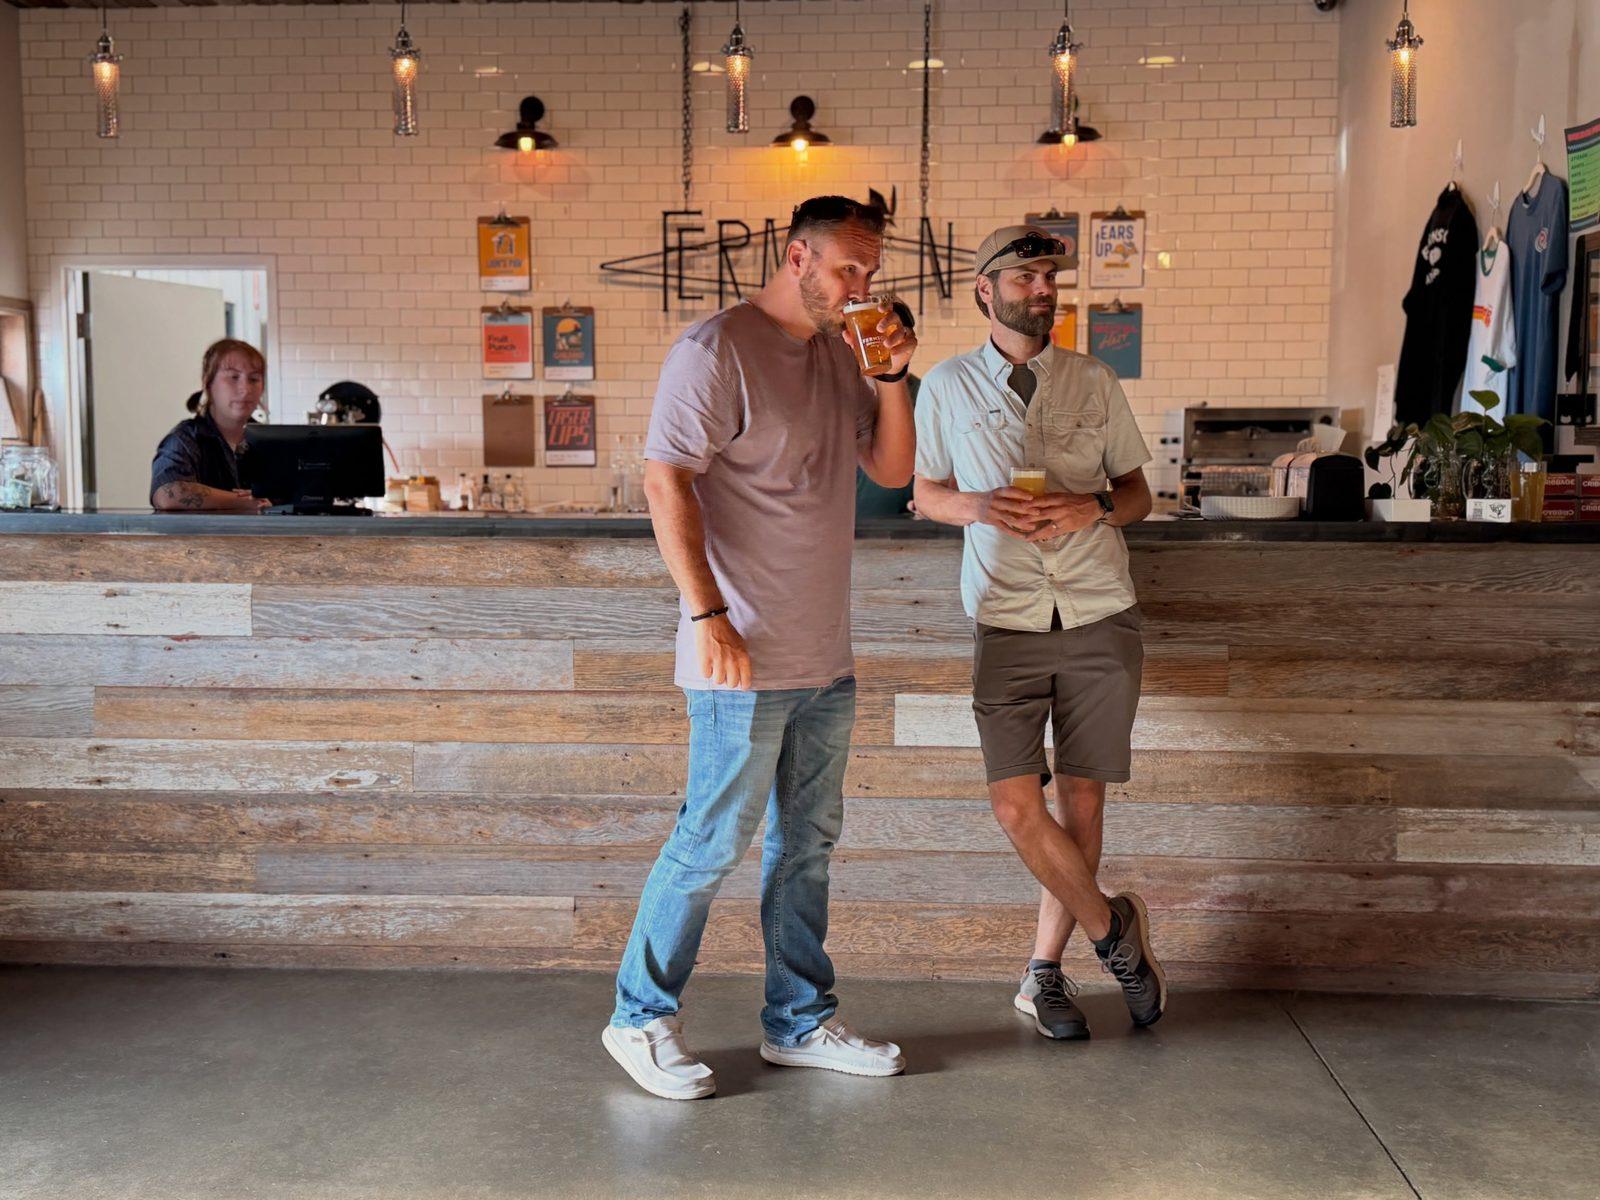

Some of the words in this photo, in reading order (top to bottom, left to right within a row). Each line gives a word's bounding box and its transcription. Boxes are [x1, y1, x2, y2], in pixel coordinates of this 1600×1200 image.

[1100, 224, 1134, 239] EARS
[1095, 231, 1112, 257] UP
[488, 334, 509, 343] Fruit
[488, 343, 517, 352] Punch
[548, 406, 591, 425] LASER
[548, 425, 590, 446] LIPS
